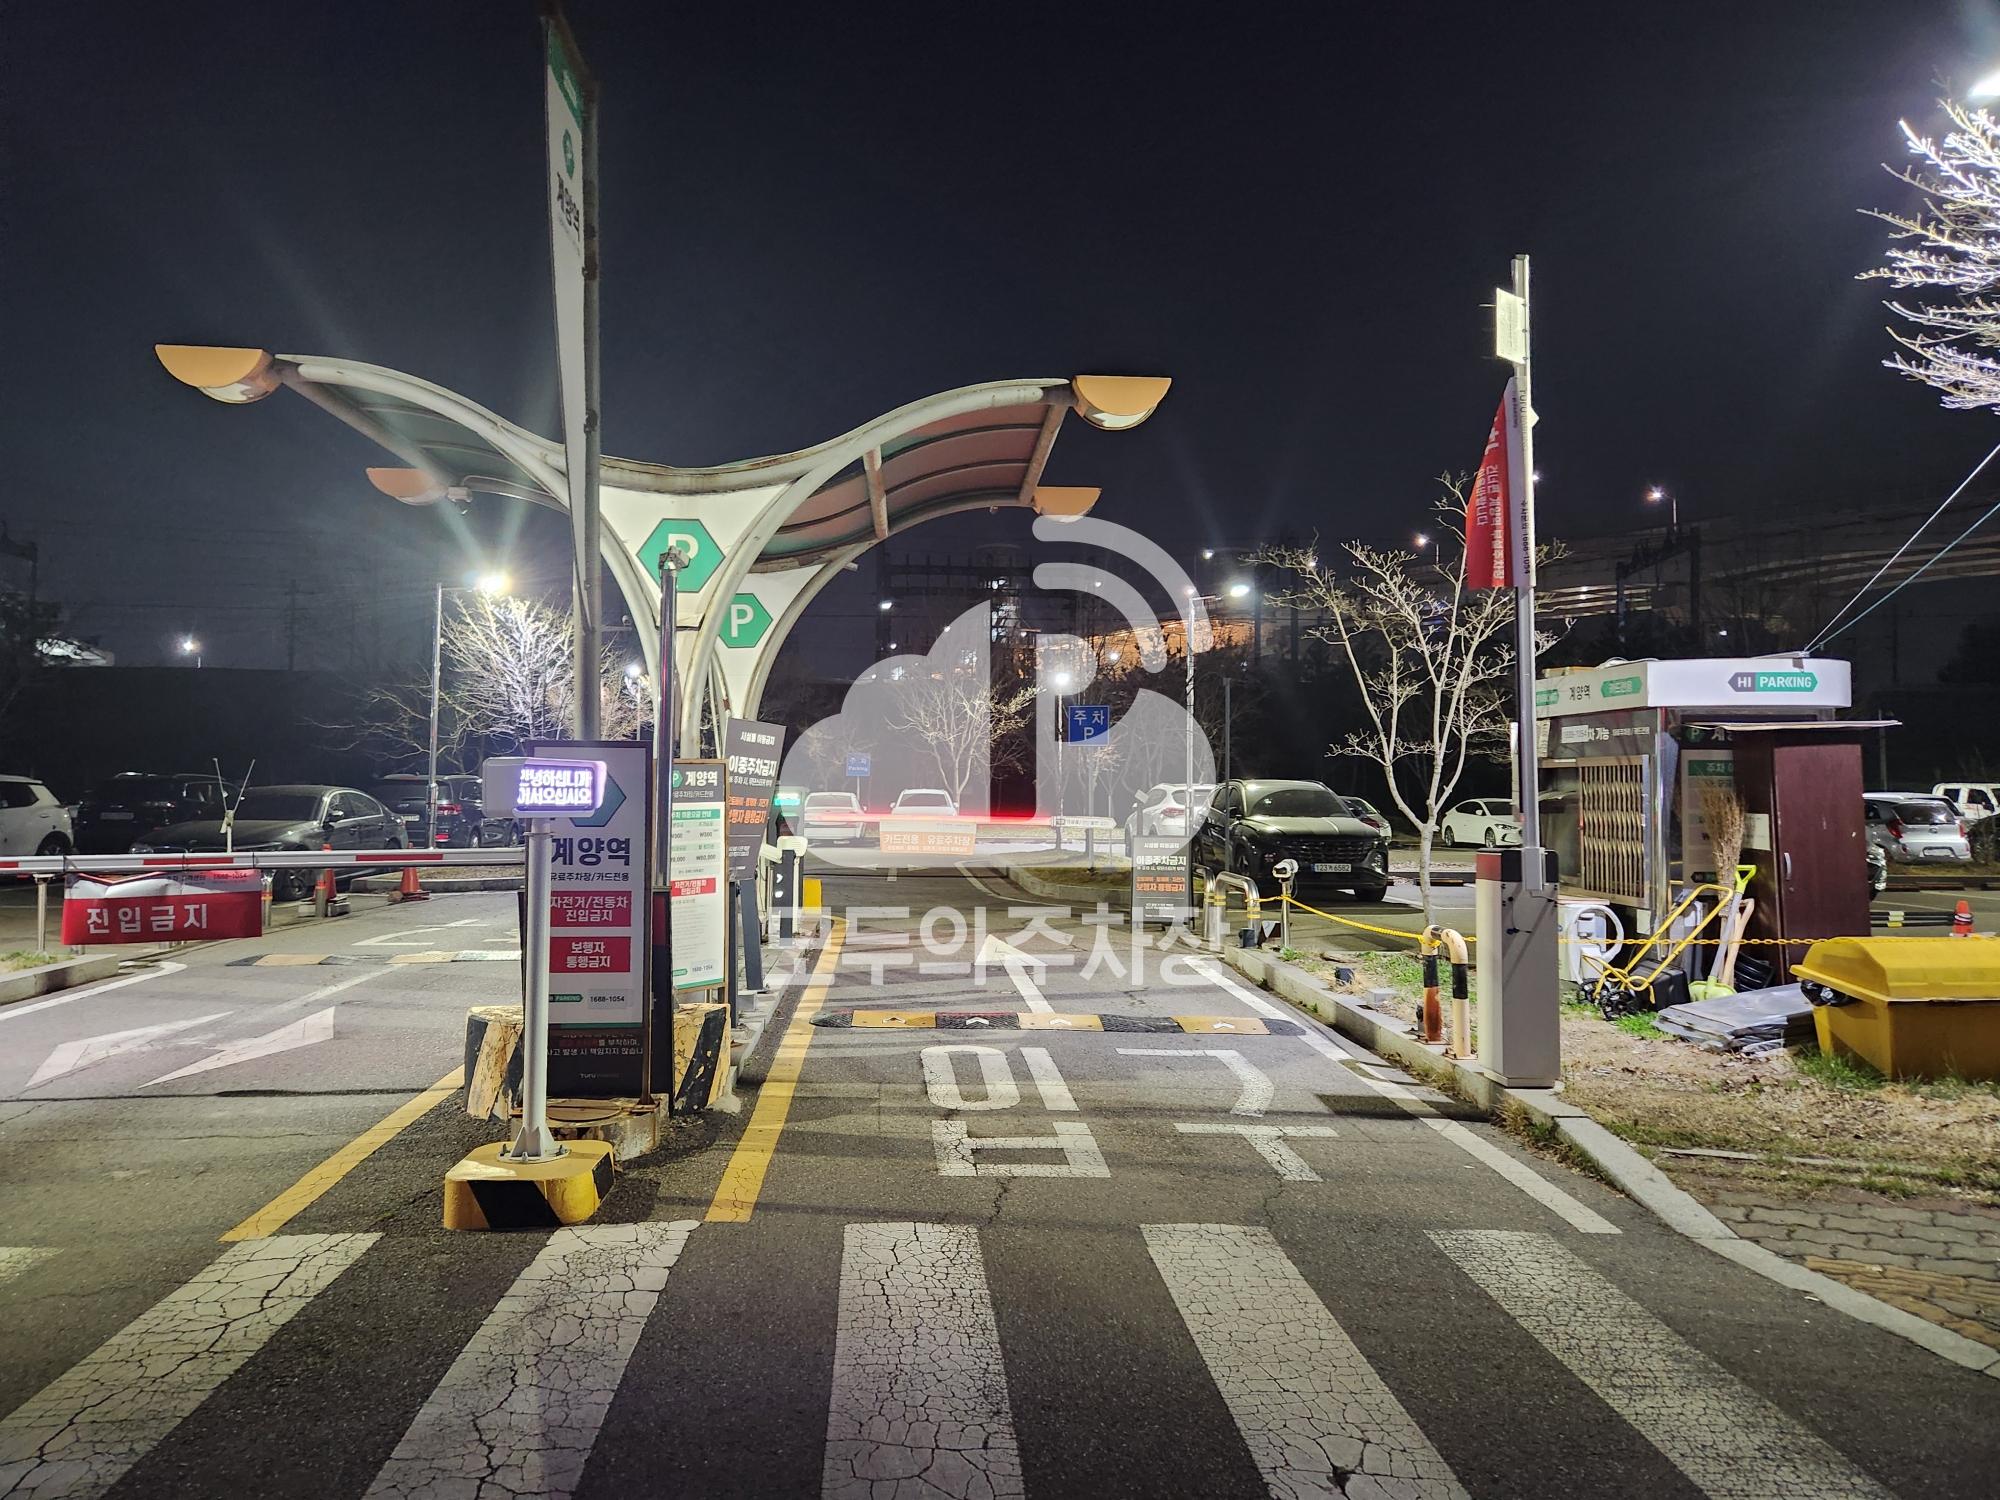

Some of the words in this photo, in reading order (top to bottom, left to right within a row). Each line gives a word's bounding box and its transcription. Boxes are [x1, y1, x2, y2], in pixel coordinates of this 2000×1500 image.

[1488, 497, 1502, 526] 계양역
[730, 604, 754, 638] P
[1738, 677, 1751, 687] HI
[1759, 676, 1812, 688] PARKING
[1569, 685, 1591, 701] 계양역
[1073, 710, 1104, 725] 주차
[1084, 727, 1094, 740] P
[728, 755, 777, 777] 이중주차금지
[685, 771, 718, 786] 계양역
[883, 834, 919, 845] 카드전용
[552, 838, 630, 867] 계양역
[1136, 855, 1187, 865] 이중주차금지
[550, 896, 628, 909] 자전거/전동차
[87, 903, 208, 934] 진입금지
[566, 909, 613, 922] 진입금지
[571, 942, 605, 954] 보행자
[566, 955, 610, 968] 통행금지
